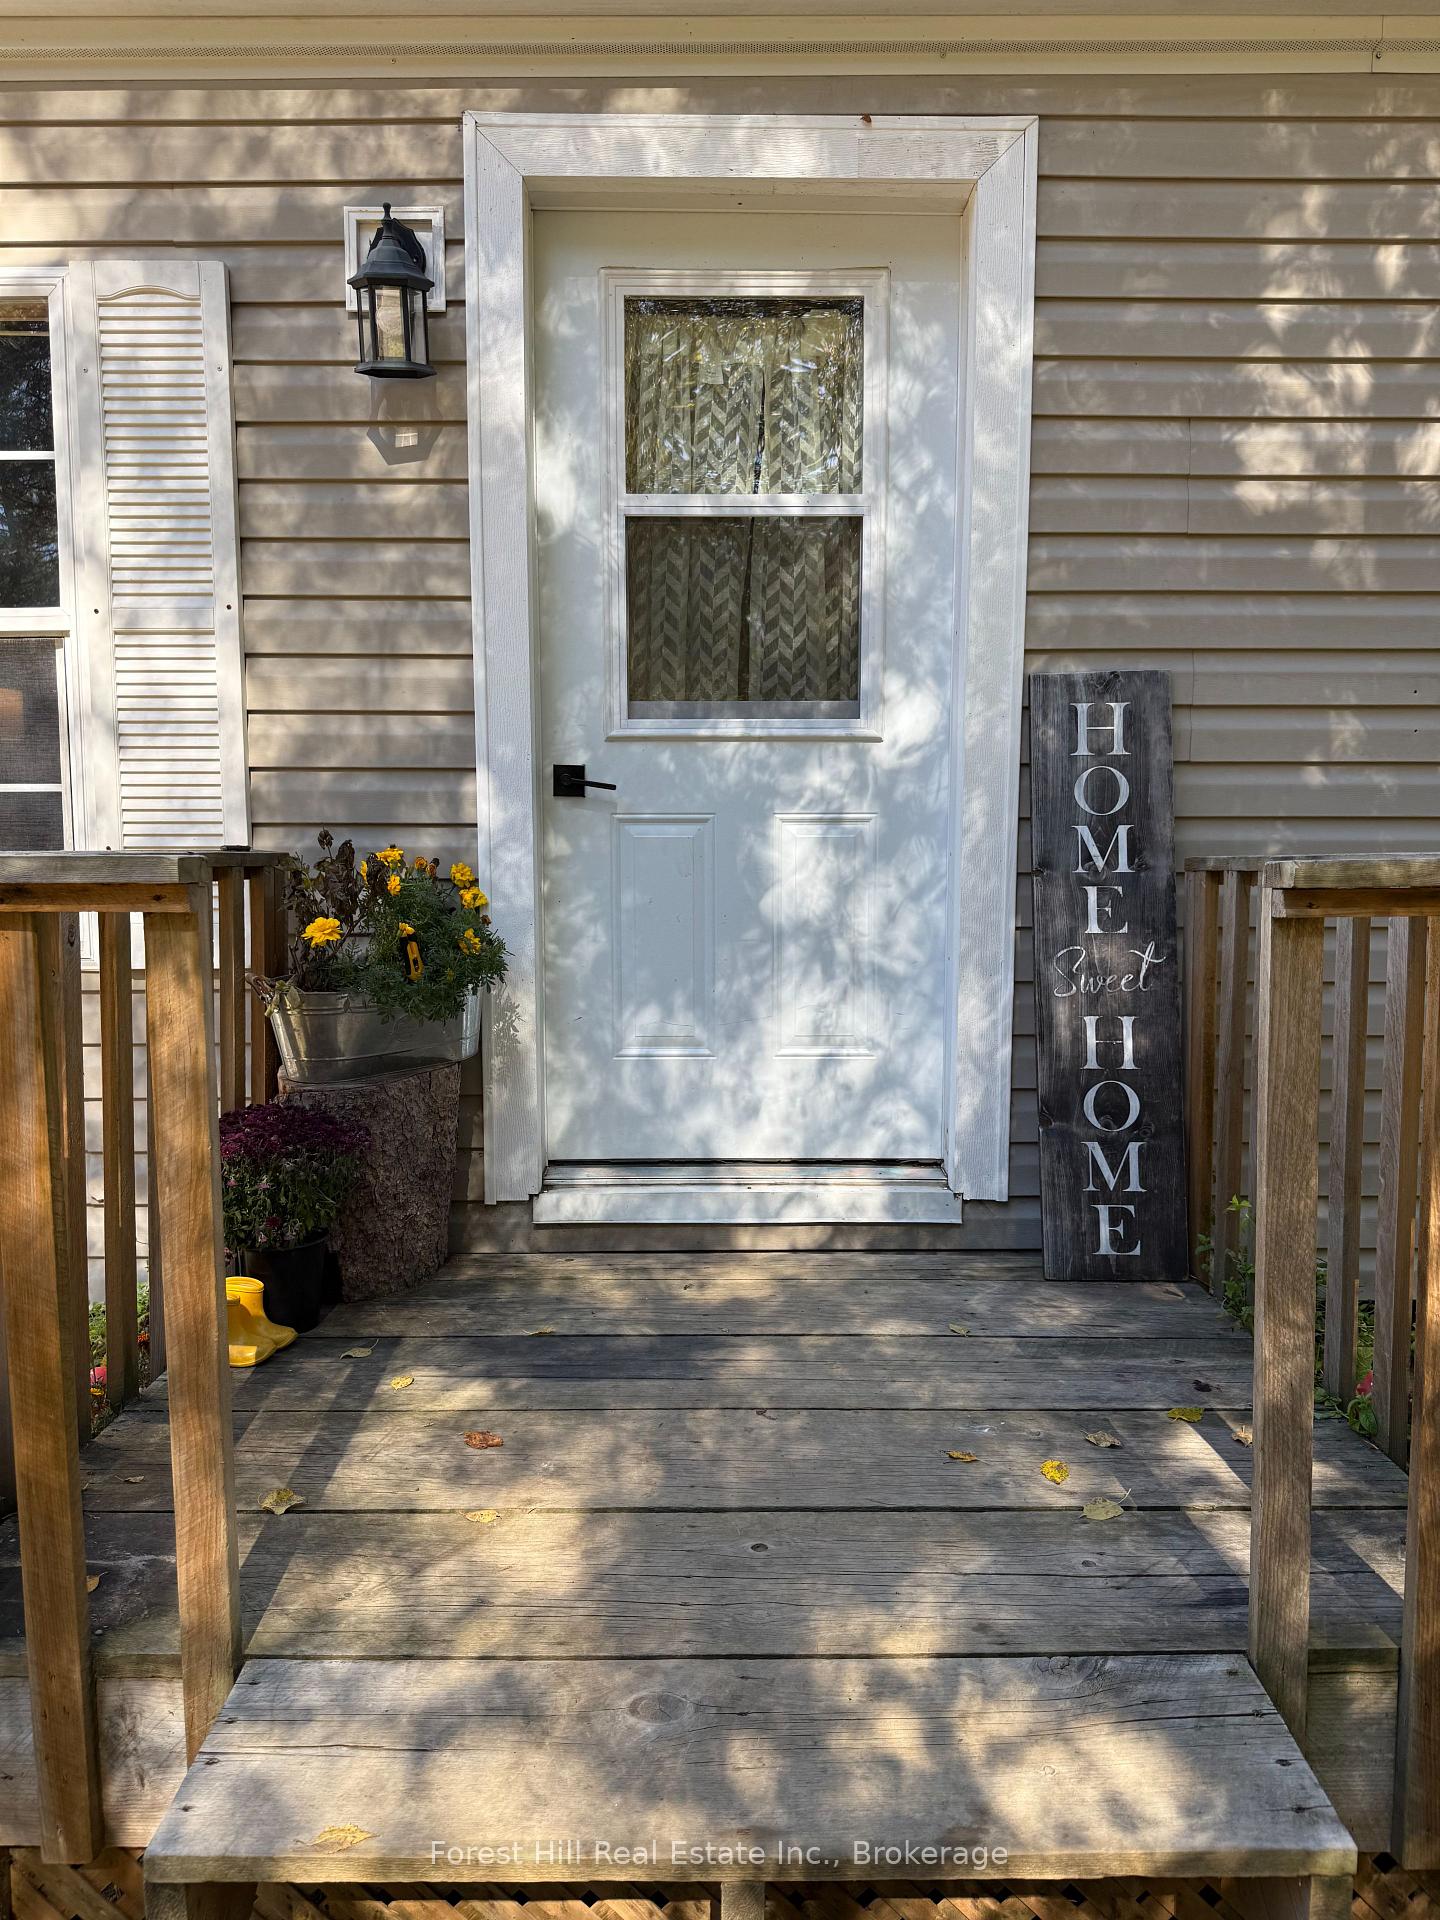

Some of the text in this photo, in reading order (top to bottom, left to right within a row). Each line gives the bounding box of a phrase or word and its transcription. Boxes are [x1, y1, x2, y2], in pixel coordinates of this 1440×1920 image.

[1069, 701, 1136, 934] HOME
[1053, 940, 1167, 997] Sweet
[1079, 1015, 1148, 1256] HOME
